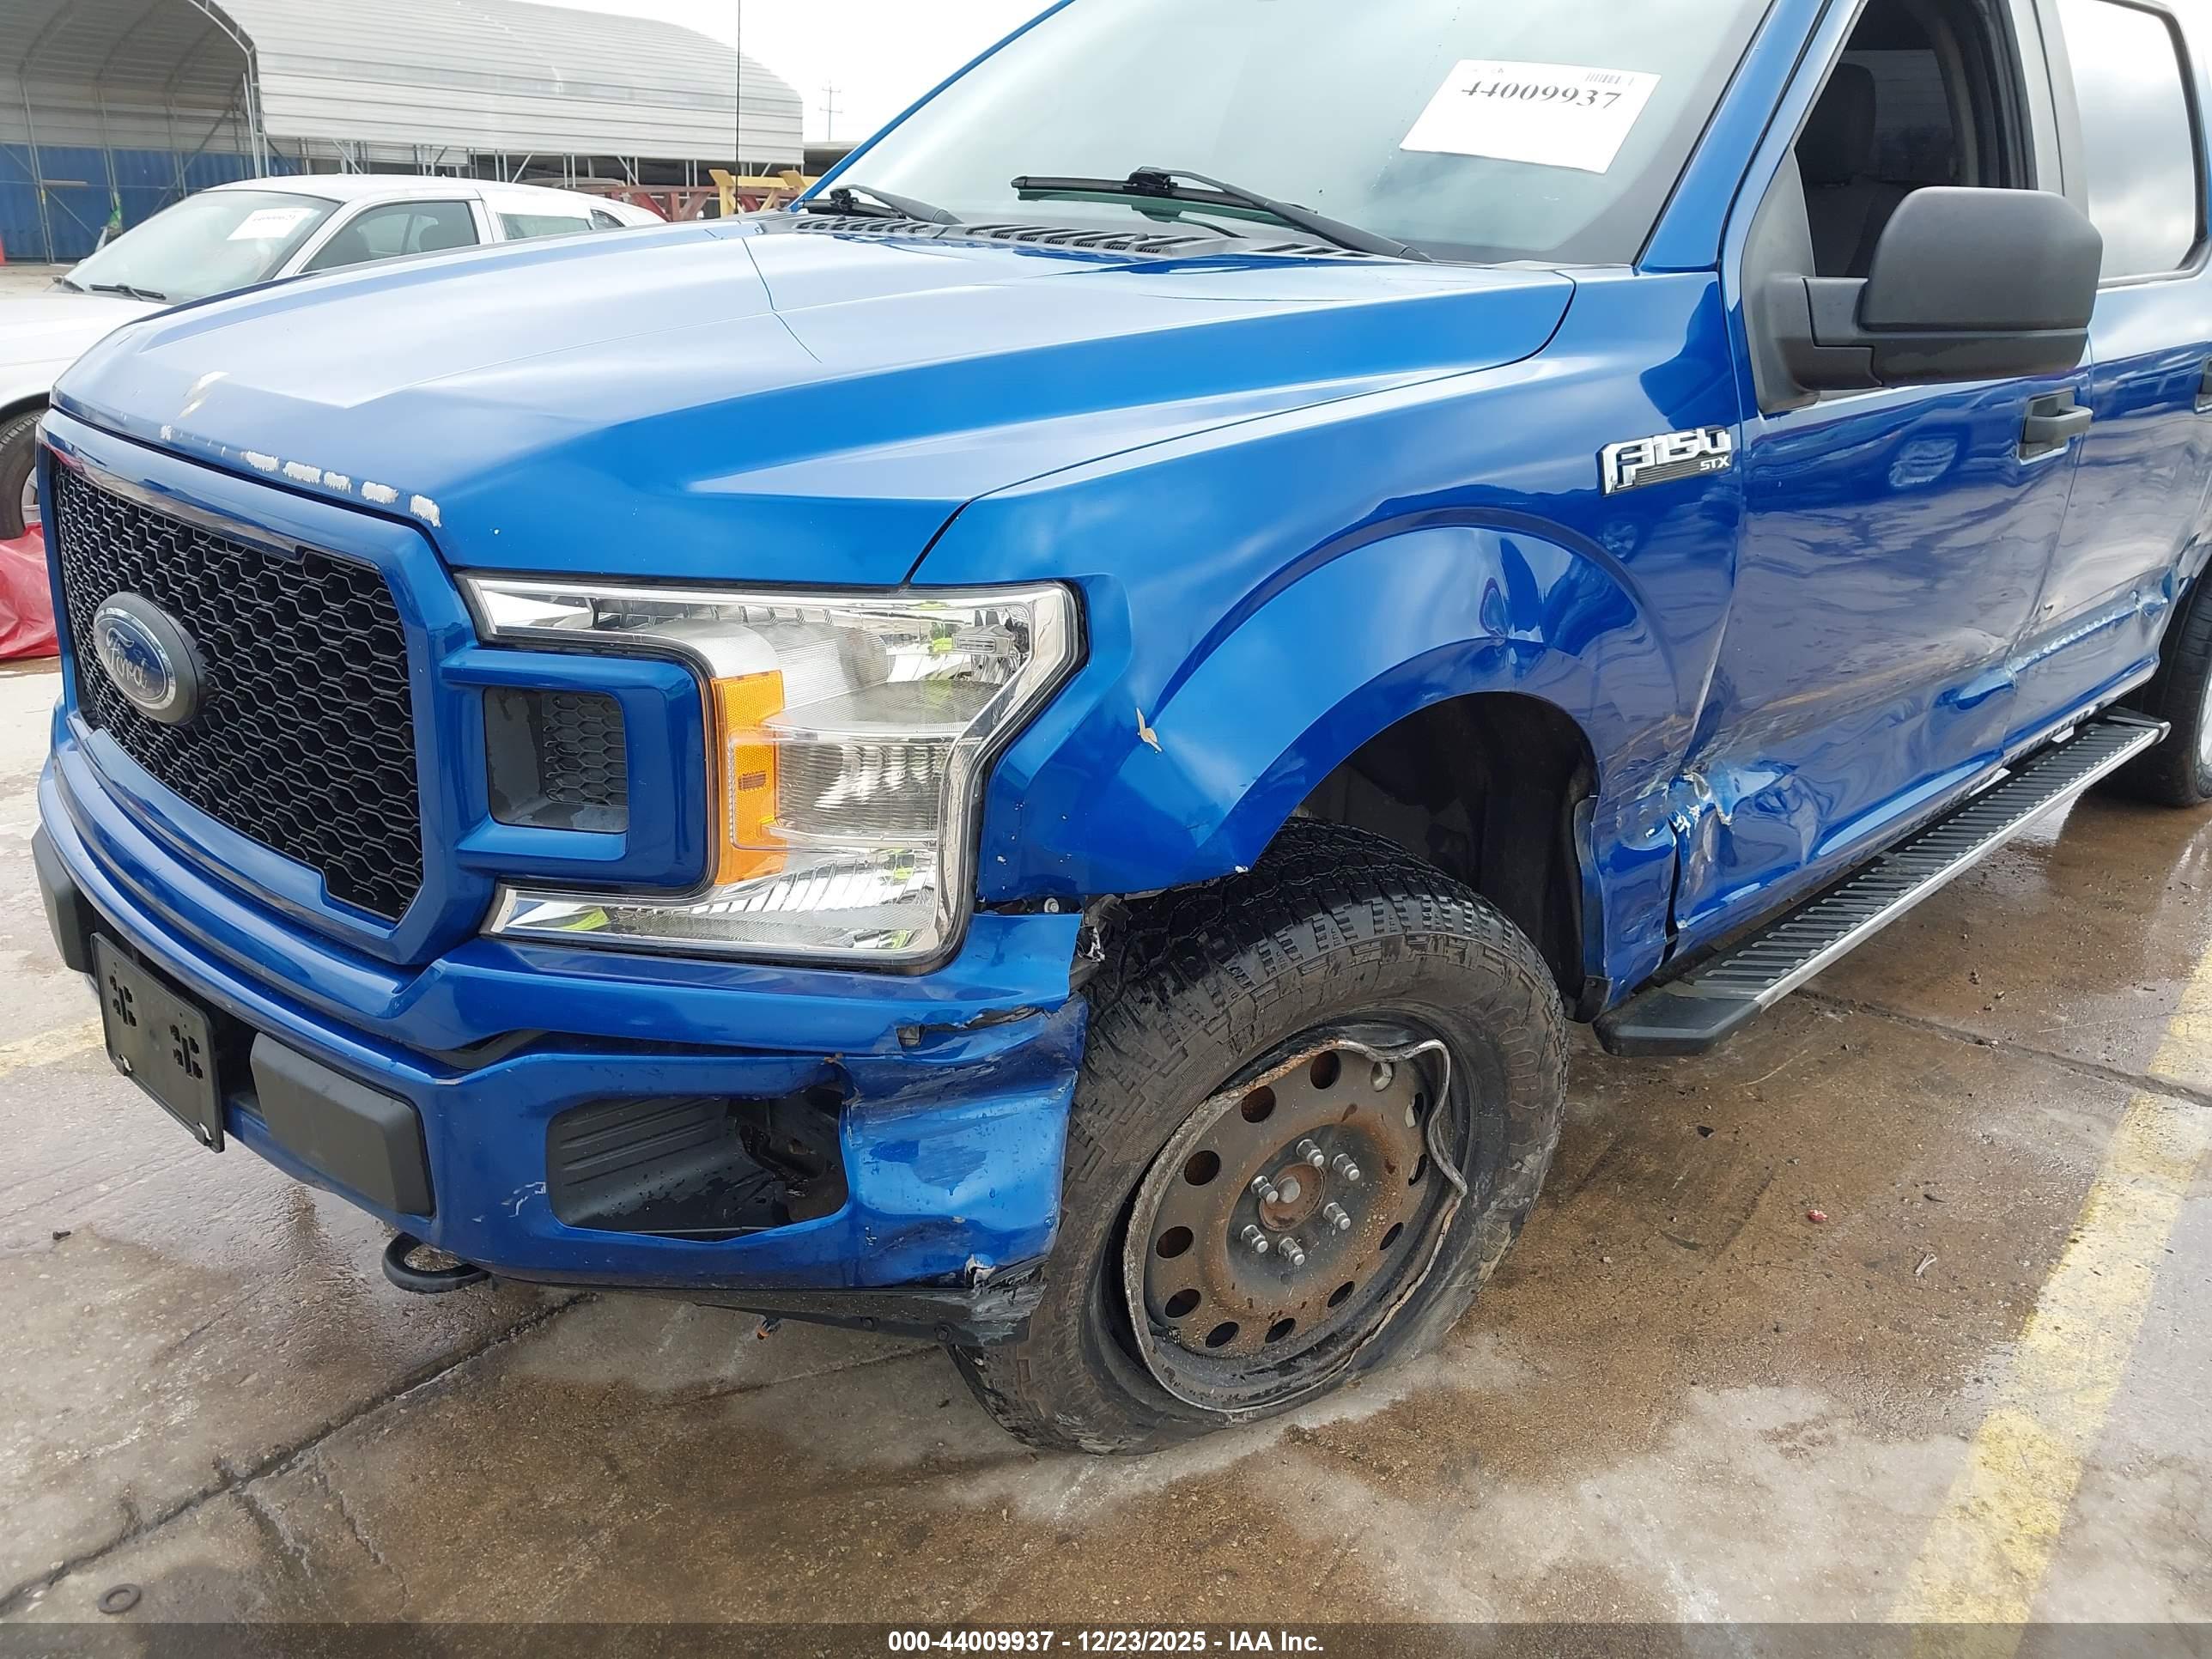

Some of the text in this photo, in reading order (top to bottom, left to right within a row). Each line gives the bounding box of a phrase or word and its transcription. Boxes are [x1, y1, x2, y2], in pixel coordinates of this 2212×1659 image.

[1462, 81, 1622, 109] 44009937
[1699, 455, 1730, 471] STX
[104, 629, 148, 690] Ford
